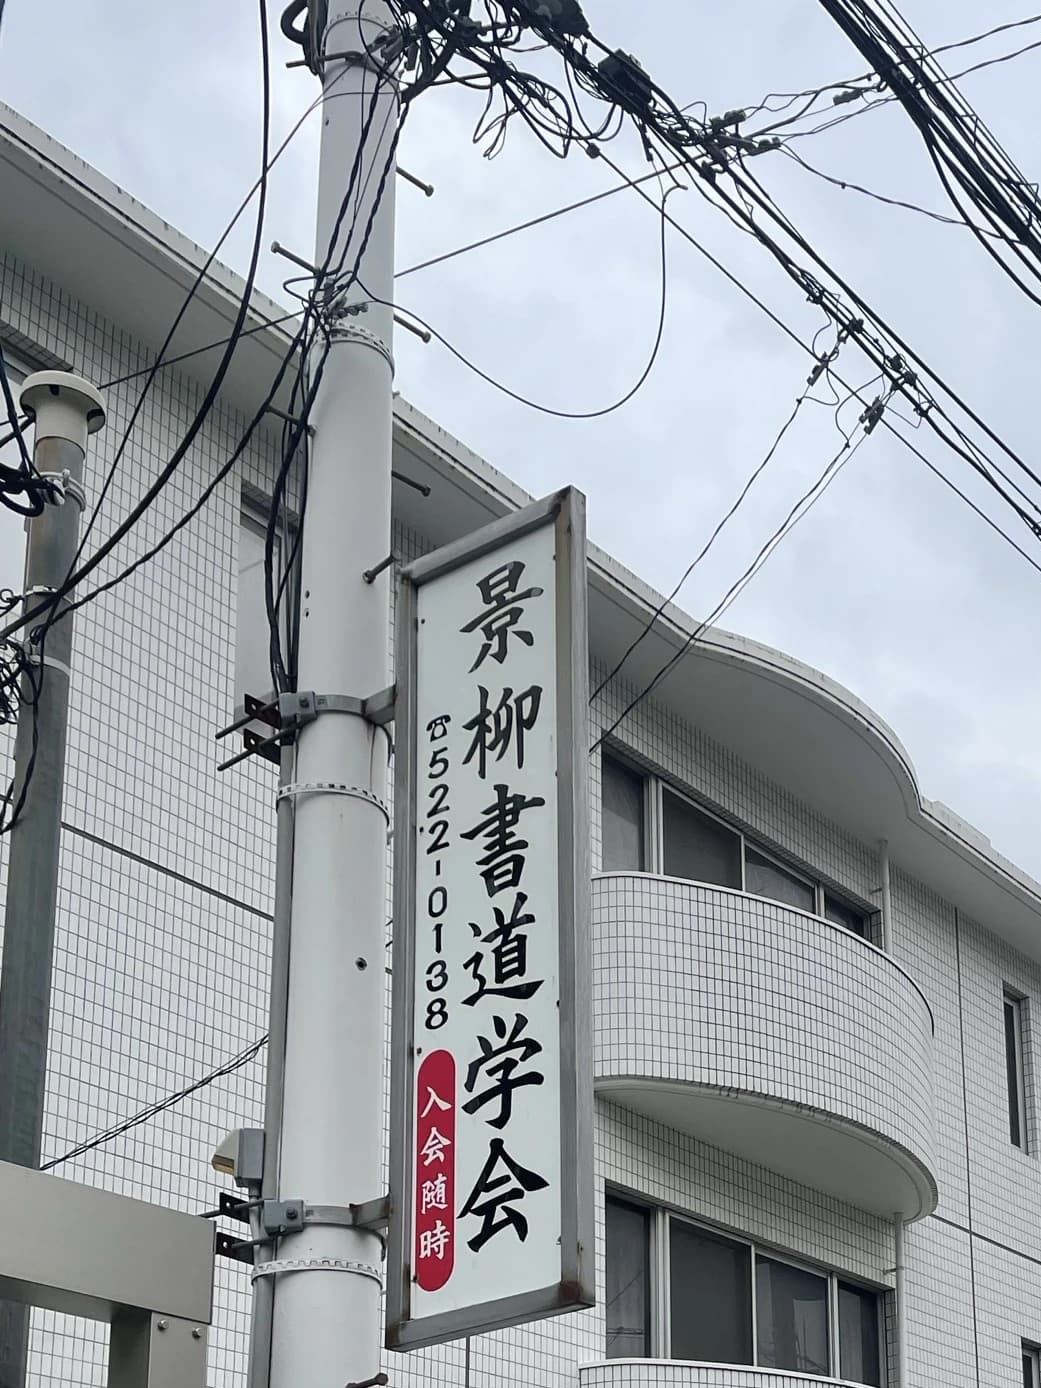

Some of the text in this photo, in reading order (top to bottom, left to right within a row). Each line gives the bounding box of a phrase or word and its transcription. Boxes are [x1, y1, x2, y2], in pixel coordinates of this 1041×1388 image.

[458, 559, 549, 1254] 景柳書道学会
[419, 1088, 452, 1261] 入会随時
